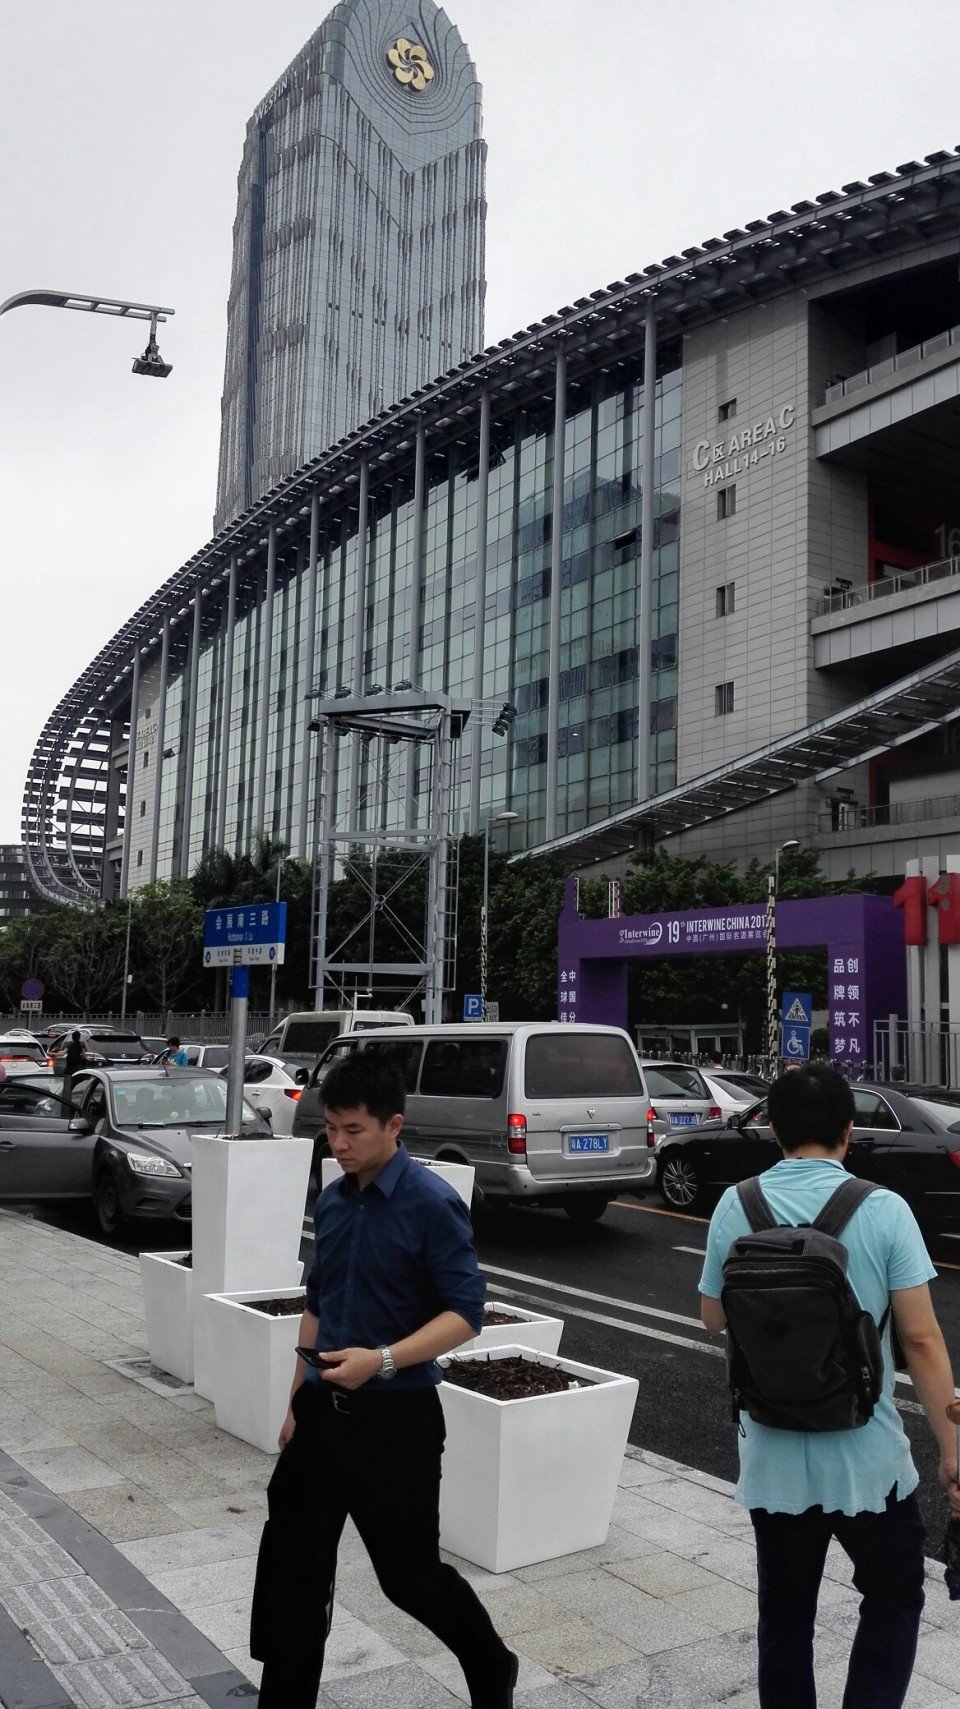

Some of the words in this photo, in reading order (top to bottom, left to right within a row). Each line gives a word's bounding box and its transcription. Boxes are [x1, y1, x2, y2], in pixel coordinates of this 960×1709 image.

[255, 75, 288, 124] WESTIN
[728, 417, 776, 456] AREA
[780, 404, 794, 429] C
[704, 458, 742, 488] HALL
[743, 436, 786, 469] 14-16
[934, 523, 960, 560] 16
[215, 909, 269, 930] 会展南三路
[686, 918, 726, 933] INTERWINE
[726, 916, 750, 931] CHINA
[468, 998, 479, 1015] P
[833, 958, 846, 1054] 品牌筑梦
[847, 958, 861, 1053] 创领不凡
